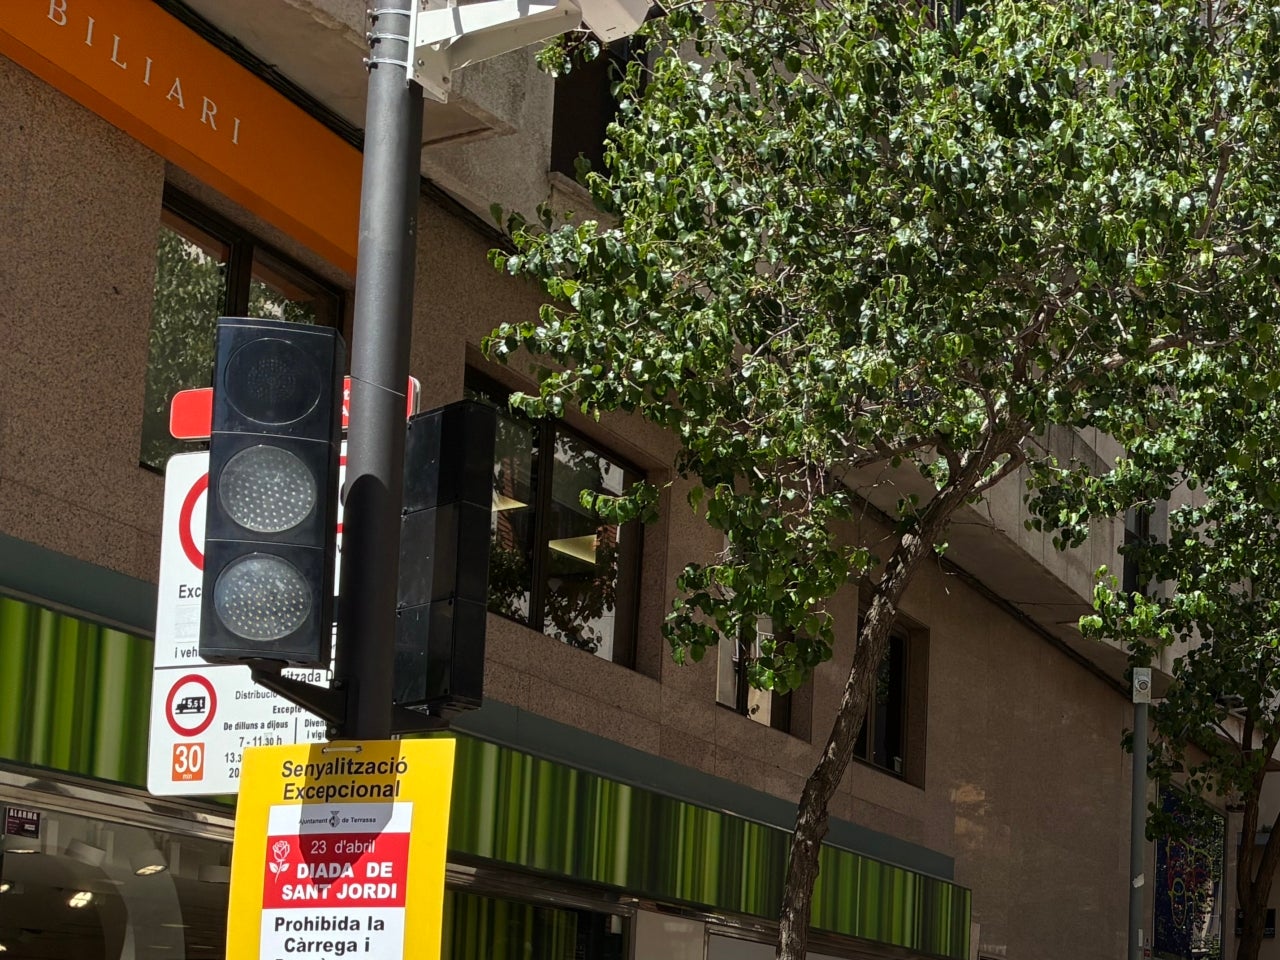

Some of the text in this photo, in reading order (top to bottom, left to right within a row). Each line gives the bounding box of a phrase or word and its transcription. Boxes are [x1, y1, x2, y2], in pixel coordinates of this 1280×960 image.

[224, 722, 233, 731] De
[235, 721, 258, 730] dilluns
[267, 720, 289, 731] dijous
[239, 736, 245, 747] 7
[276, 735, 282, 745] h
[175, 744, 202, 773] 30
[281, 756, 408, 781] Senyalització
[283, 780, 401, 803] Excepcional
[9, 808, 38, 821] ALARMA
[311, 839, 375, 854] 23 d'abril
[297, 861, 393, 879] DIADA DE
[282, 883, 397, 900] SANT JORDI
[274, 915, 385, 932] Prohibida la
[284, 937, 370, 956] Càrrega i
